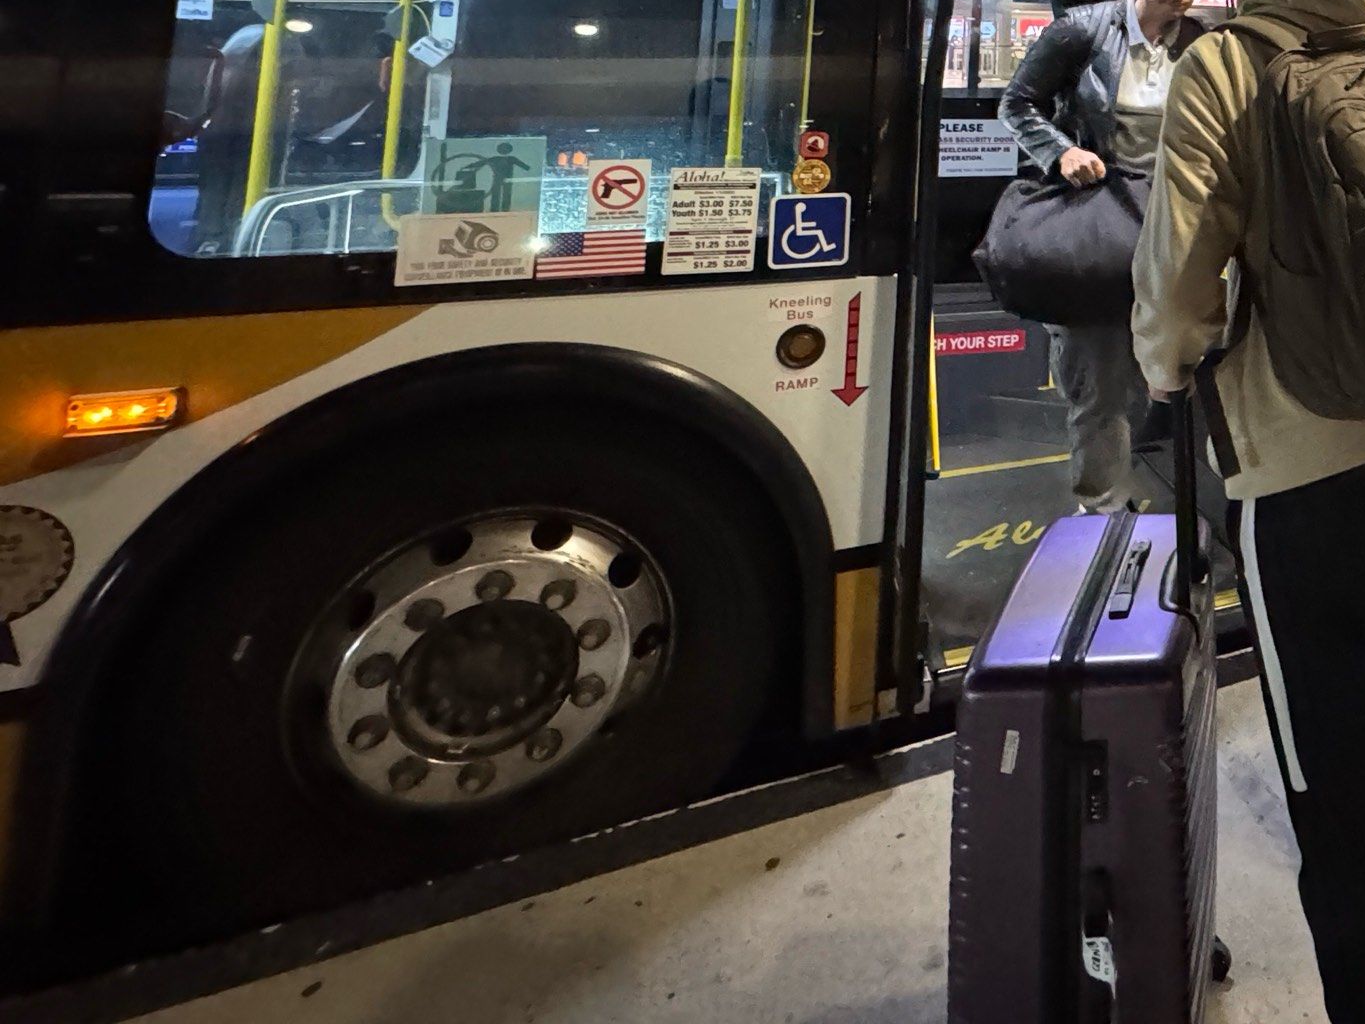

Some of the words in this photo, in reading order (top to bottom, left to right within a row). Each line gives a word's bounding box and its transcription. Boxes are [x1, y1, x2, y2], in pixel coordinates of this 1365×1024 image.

[939, 124, 984, 132] PLEASE
[675, 171, 726, 182] Aloha!
[695, 241, 719, 249] $1.25
[725, 240, 749, 248] $3.00
[693, 261, 717, 269] $1.25
[723, 260, 747, 268] $2.00
[769, 295, 831, 311] Kneeling
[787, 310, 813, 320] Bus
[950, 337, 985, 350] YOUR
[987, 334, 1019, 348] STEP
[776, 377, 819, 392] RAMP
